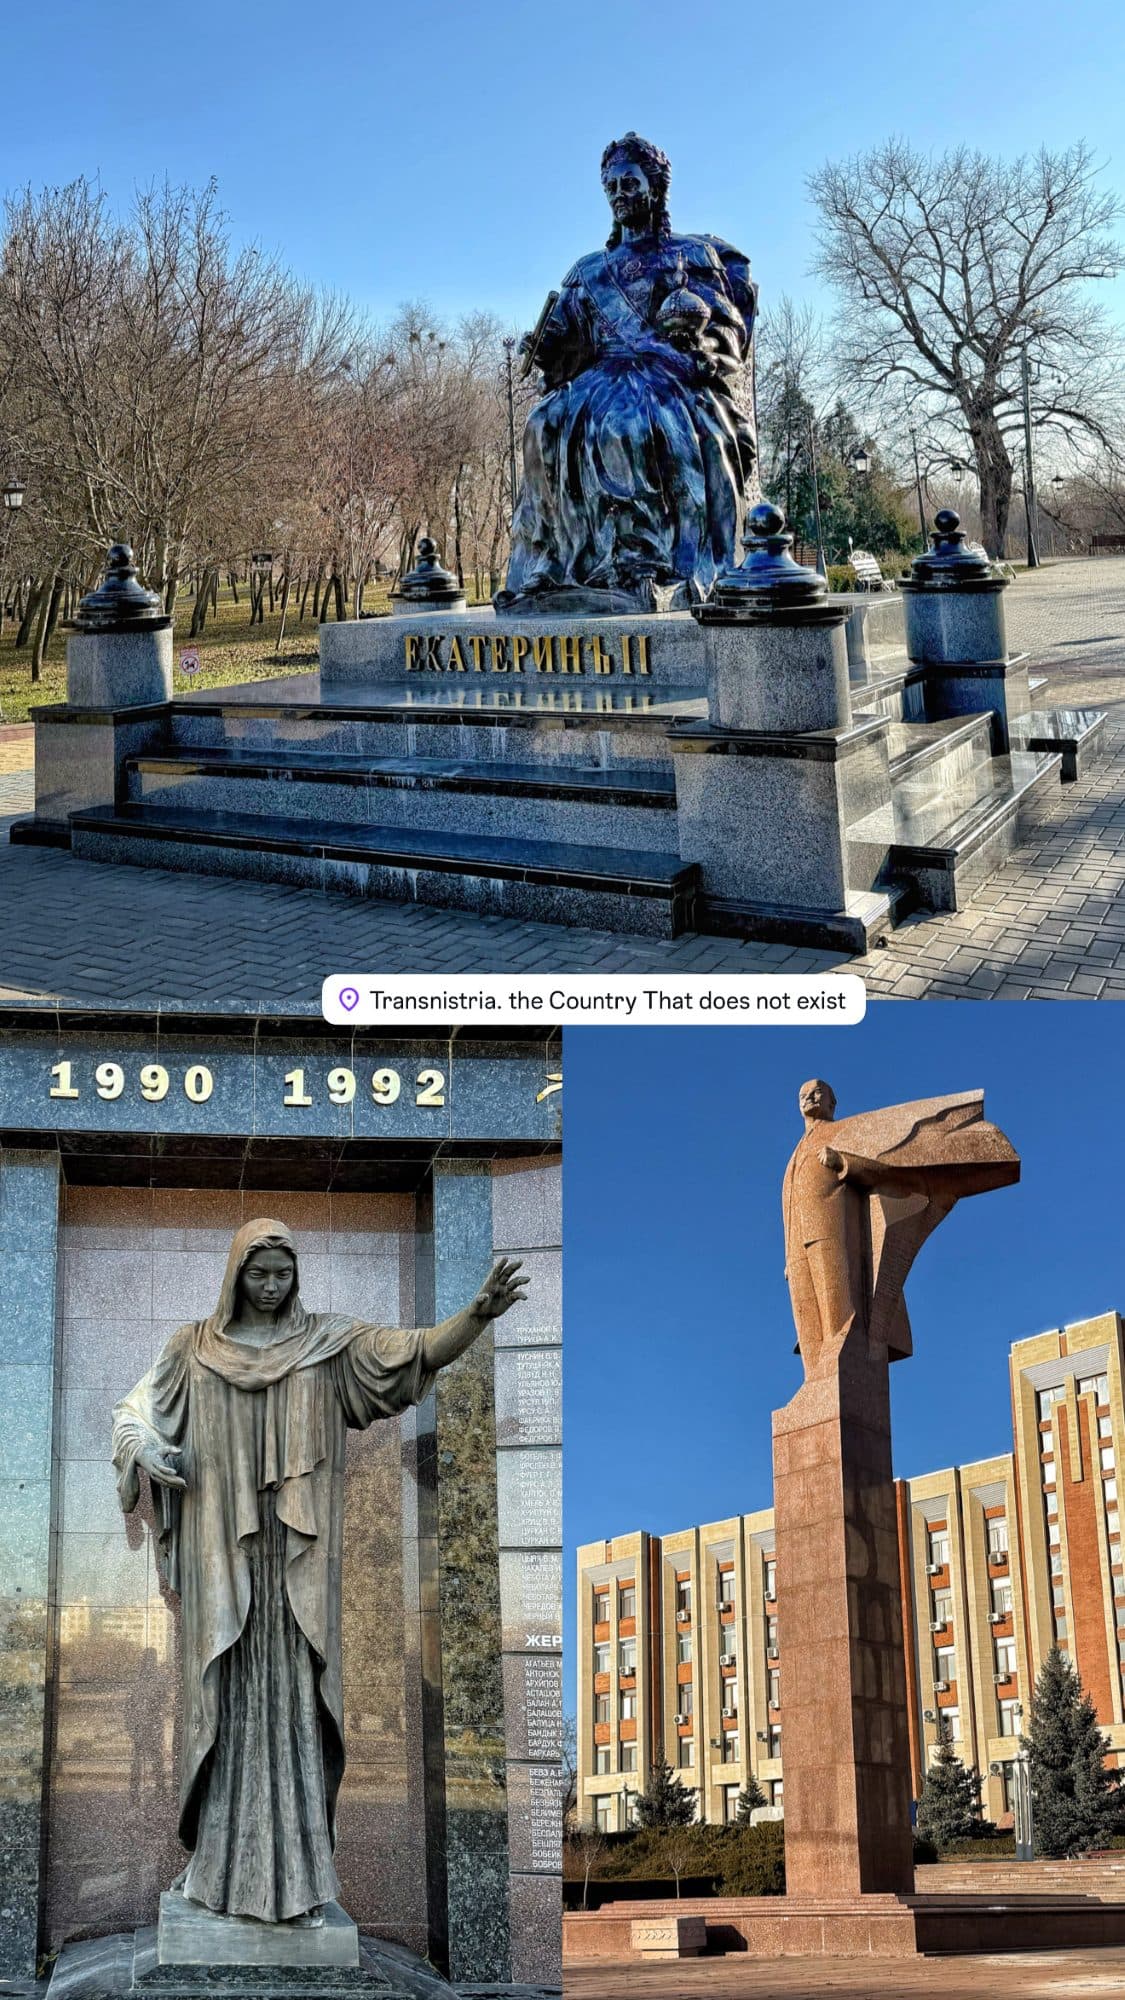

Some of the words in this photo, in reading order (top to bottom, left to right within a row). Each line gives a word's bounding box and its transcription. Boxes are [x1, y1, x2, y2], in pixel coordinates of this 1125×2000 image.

[49, 1061, 214, 1104] 1990
[283, 1068, 446, 1107] 1992
[525, 1634, 563, 1647] ЖЕР
[525, 1670, 560, 1678] АНТОНЮК
[525, 1680, 559, 1688] АРХИПОВ
[527, 1699, 550, 1707] БАЛАН
[528, 1739, 556, 1748] БАРДУК
[529, 1768, 549, 1777] БЕВЗ
[531, 1809, 563, 1818] БЕЛИМЕ
[531, 1819, 563, 1828] БЕРЕЖН
[532, 1829, 563, 1838] БЕСПАЛ
